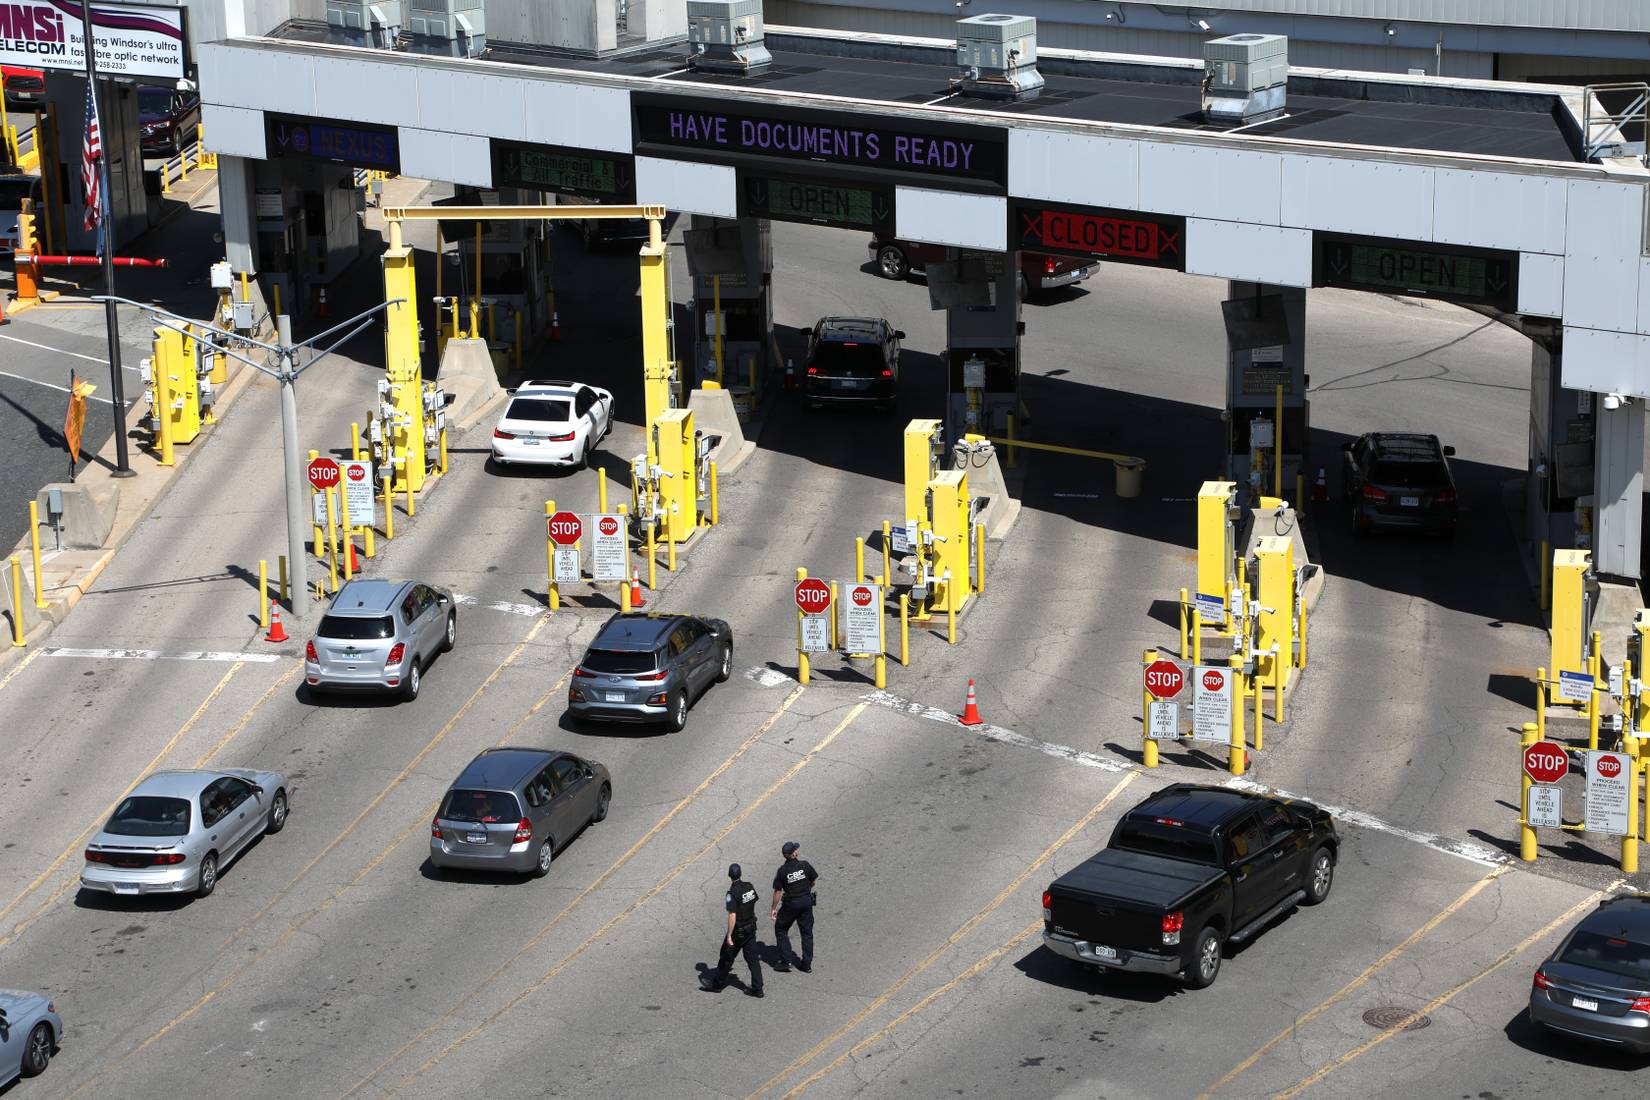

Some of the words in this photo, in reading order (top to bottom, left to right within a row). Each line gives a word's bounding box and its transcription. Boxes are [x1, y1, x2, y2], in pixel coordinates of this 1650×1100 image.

[70, 34, 107, 48] Buiing
[110, 37, 153, 50] Windsor's
[156, 41, 177, 51] ultra
[71, 46, 85, 57] fas
[114, 51, 138, 62] optic
[141, 54, 180, 65] network
[320, 127, 385, 160] NEXUS
[670, 113, 728, 144] HAVE
[741, 120, 880, 160] DOCUMENTS
[895, 136, 974, 170] READY
[525, 152, 593, 173] Commercial
[534, 167, 549, 183] All
[559, 170, 602, 188] Traffic
[790, 186, 849, 216] OPEN
[1049, 217, 1151, 254] CLOSED
[1379, 252, 1457, 288] OPEN
[311, 468, 338, 480] STOP
[552, 522, 579, 535] STOP
[798, 590, 828, 602] STOP
[1148, 672, 1180, 686] STOP
[1204, 676, 1223, 685] STOP
[1528, 753, 1564, 771] STOP
[1598, 761, 1620, 772] STOP
[787, 870, 804, 880] CBP
